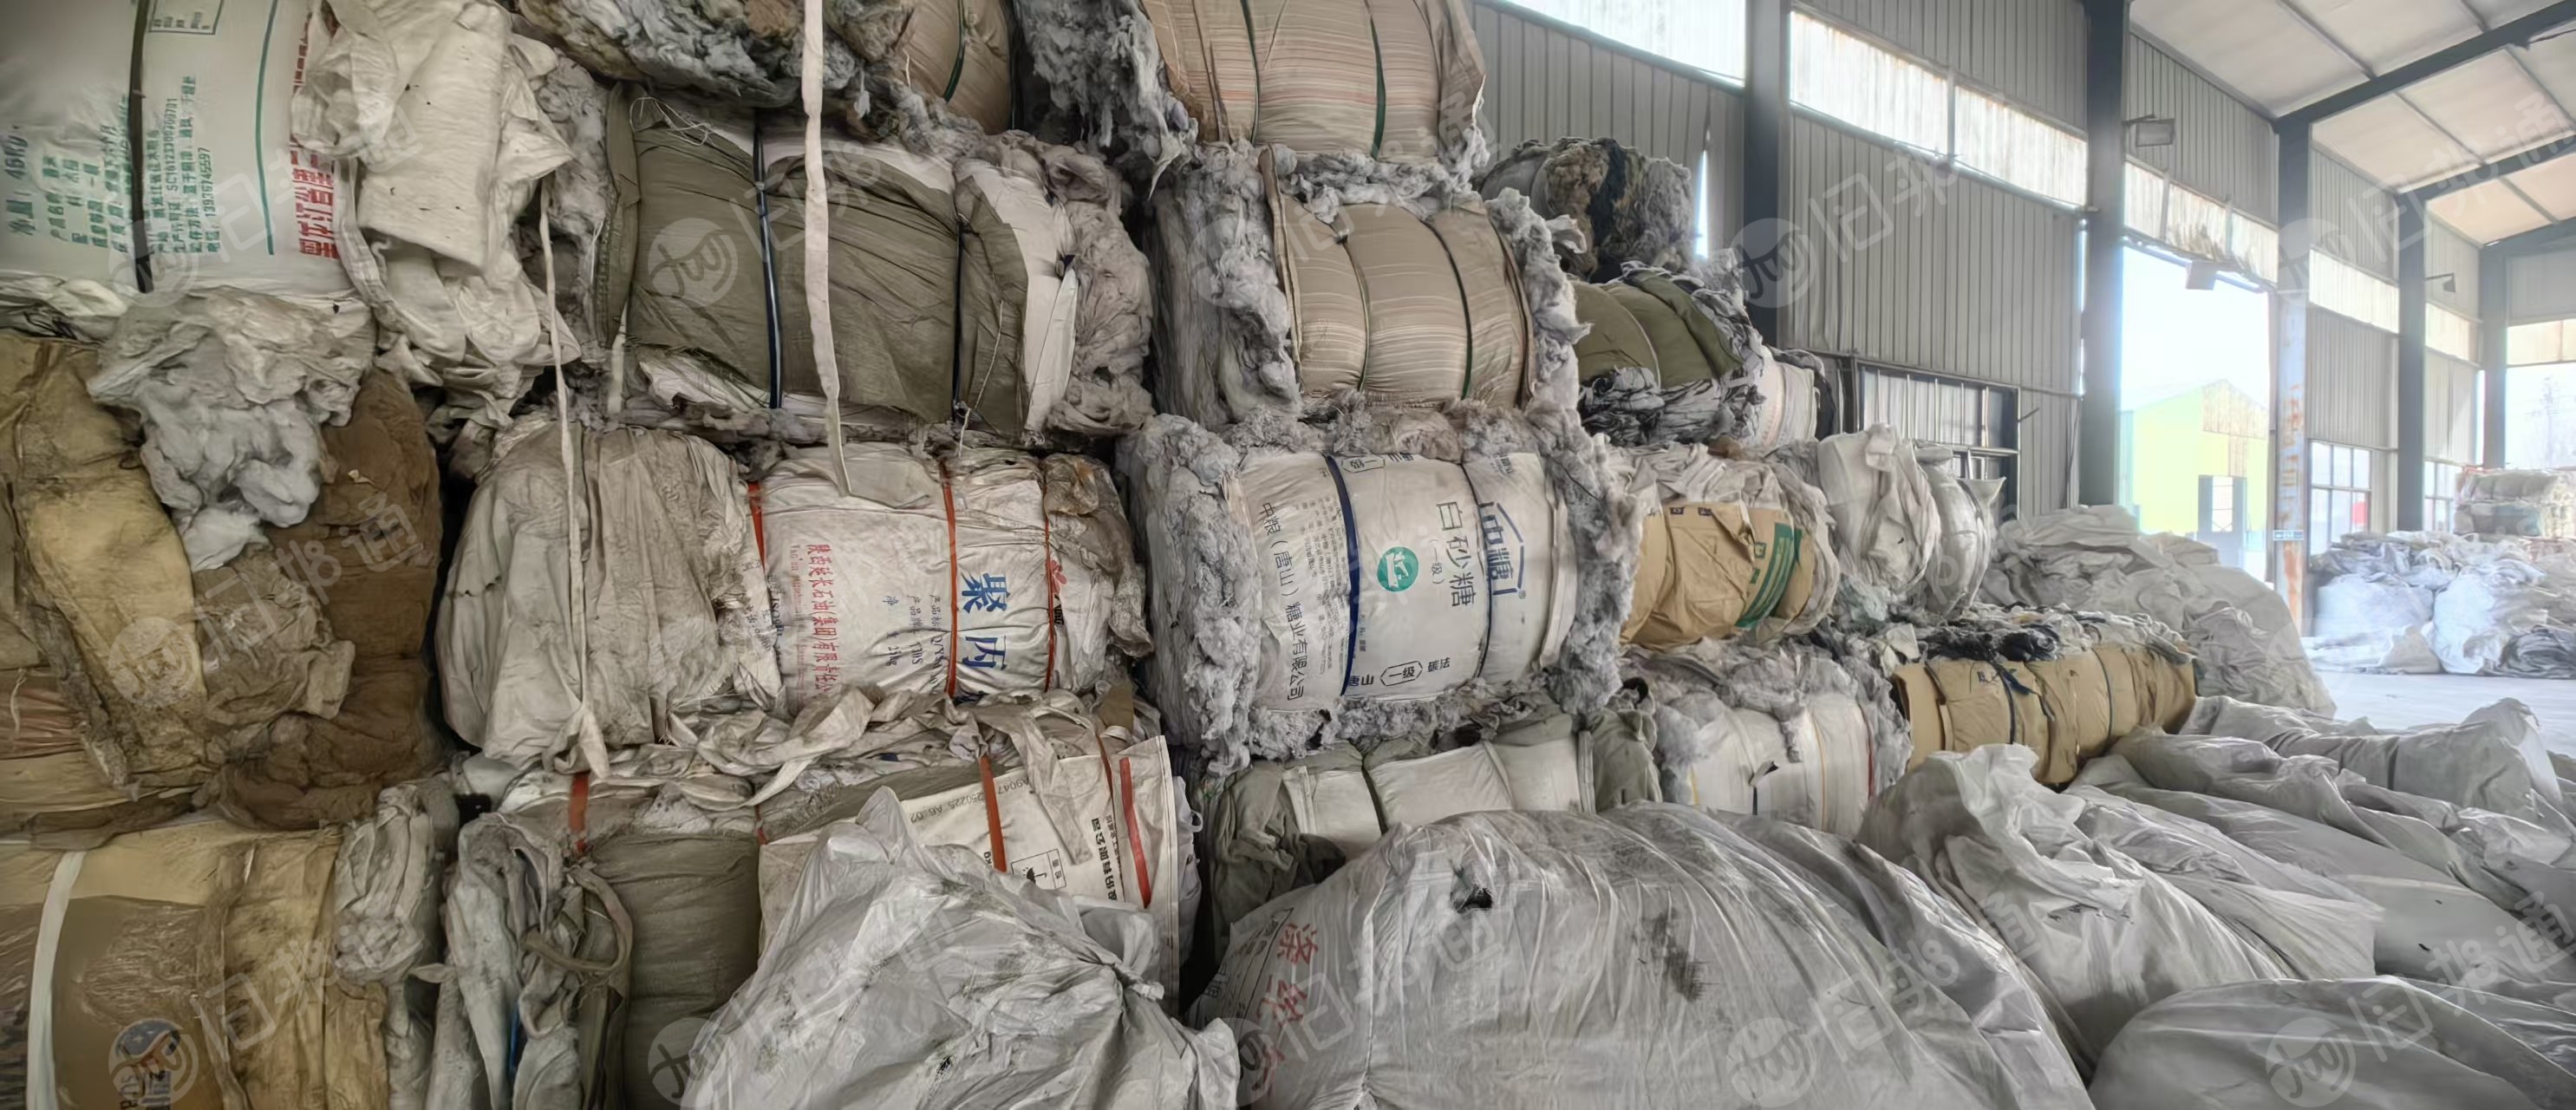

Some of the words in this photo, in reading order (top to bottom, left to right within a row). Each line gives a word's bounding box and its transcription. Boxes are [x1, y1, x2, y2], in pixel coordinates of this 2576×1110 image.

[1436, 501, 1477, 608] 白砂糖
[1388, 666, 1415, 679] 一级
